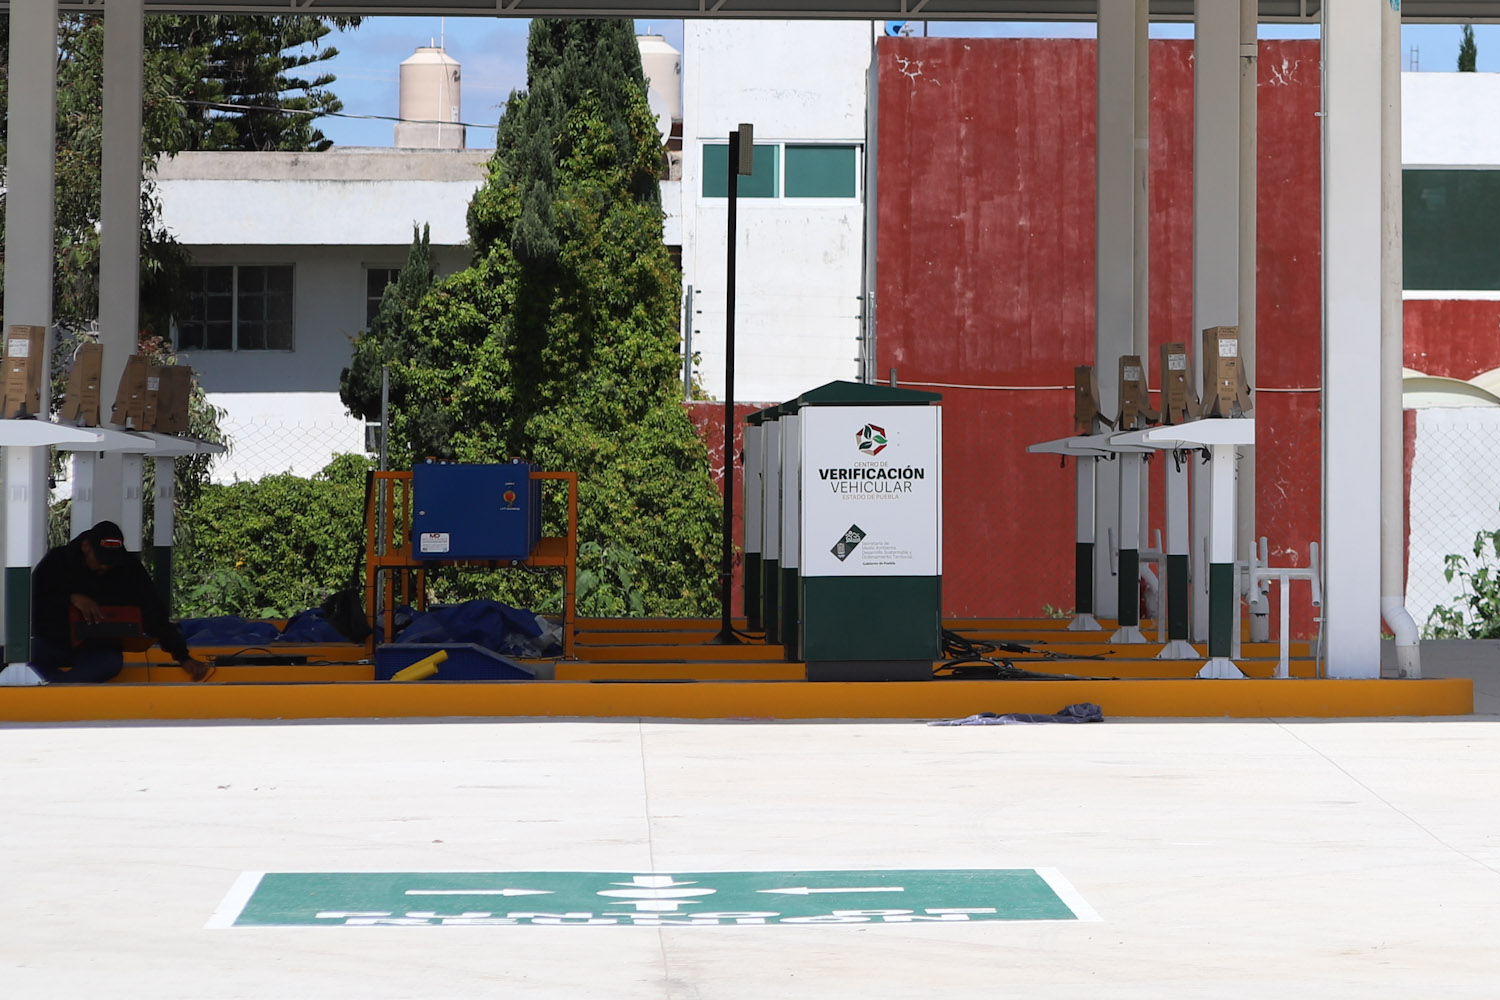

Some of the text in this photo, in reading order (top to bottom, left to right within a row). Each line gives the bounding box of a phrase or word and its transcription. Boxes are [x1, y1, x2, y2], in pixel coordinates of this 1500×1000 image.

[818, 465, 925, 480] VERIFICACIÓN
[830, 481, 912, 493] VEHICULAR
[314, 911, 782, 919] PUNTO
